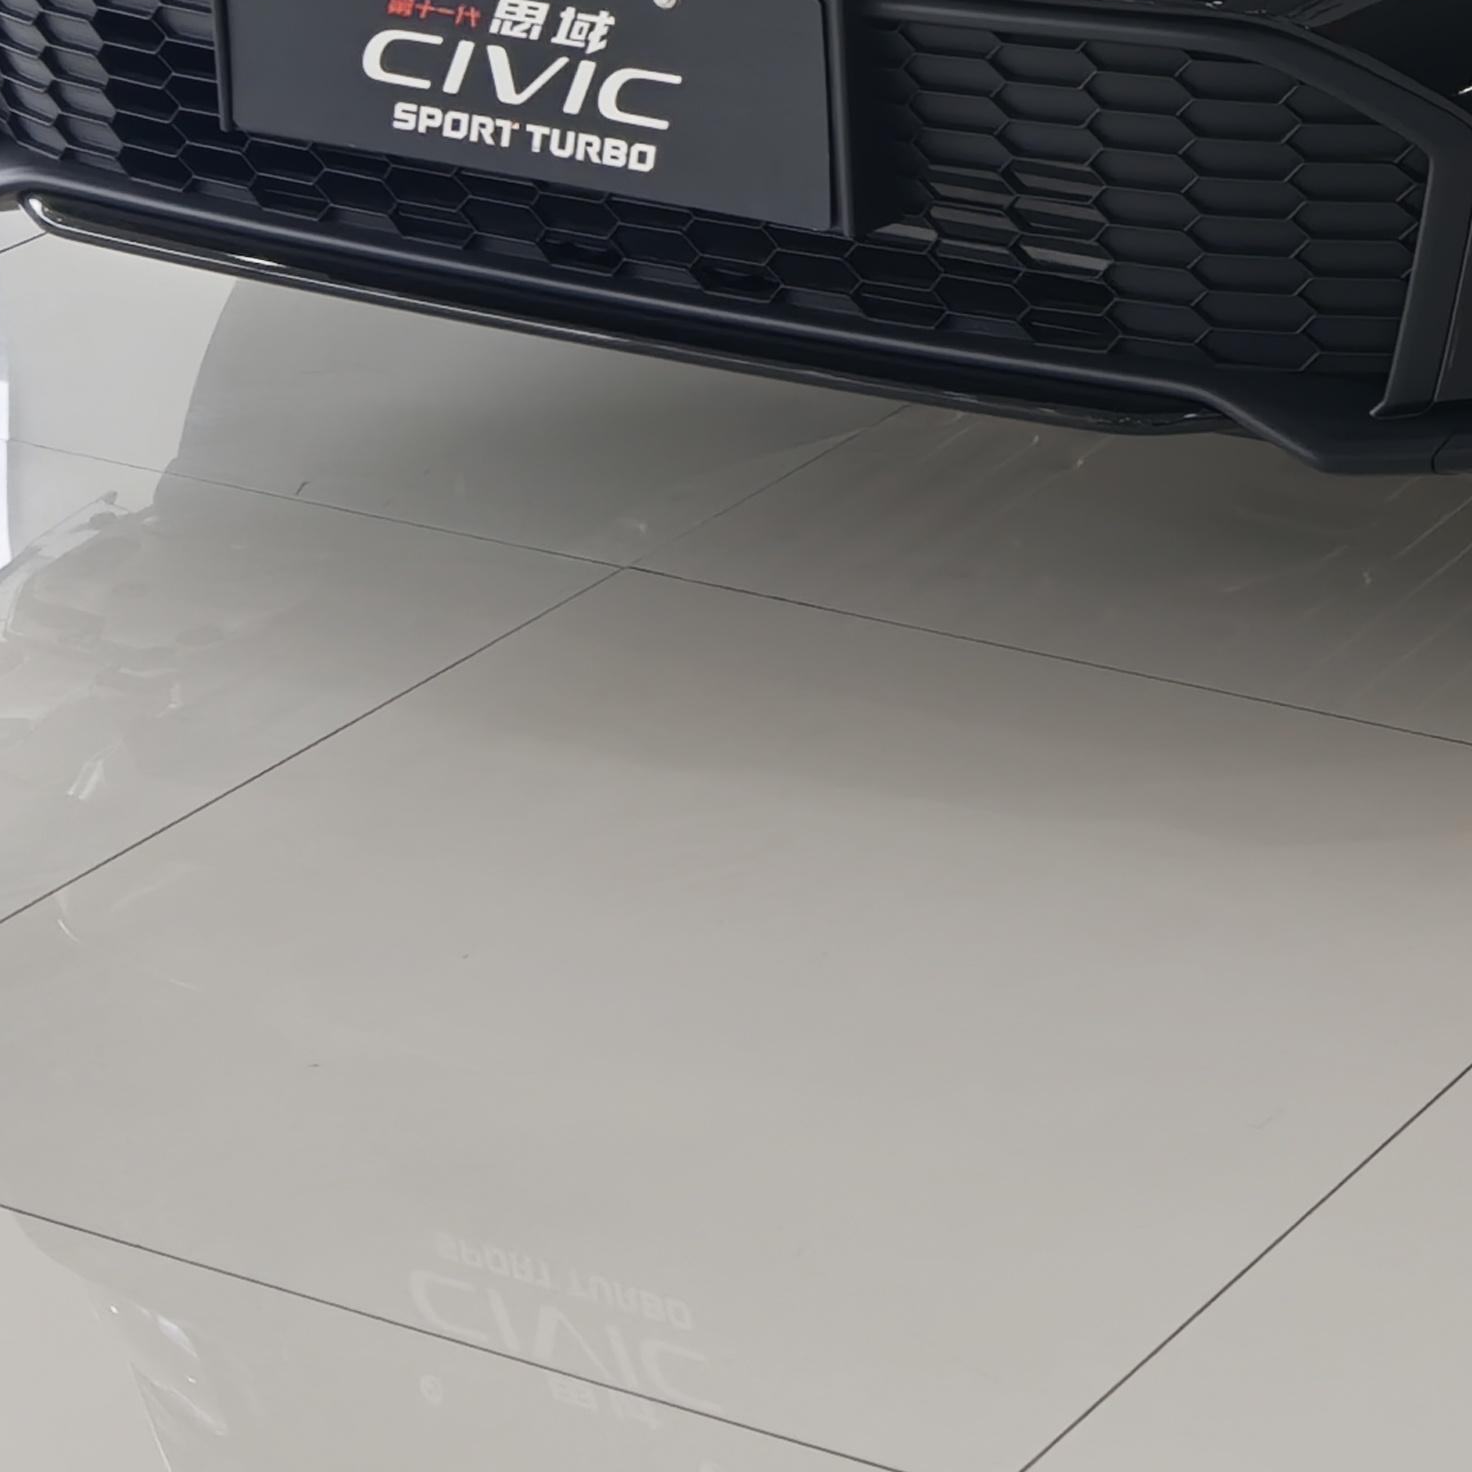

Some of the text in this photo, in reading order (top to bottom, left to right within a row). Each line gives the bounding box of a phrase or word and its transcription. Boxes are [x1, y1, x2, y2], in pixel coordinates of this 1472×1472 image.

[361, 28, 683, 131] CIVIC
[391, 101, 658, 174] SPORT TURBO
